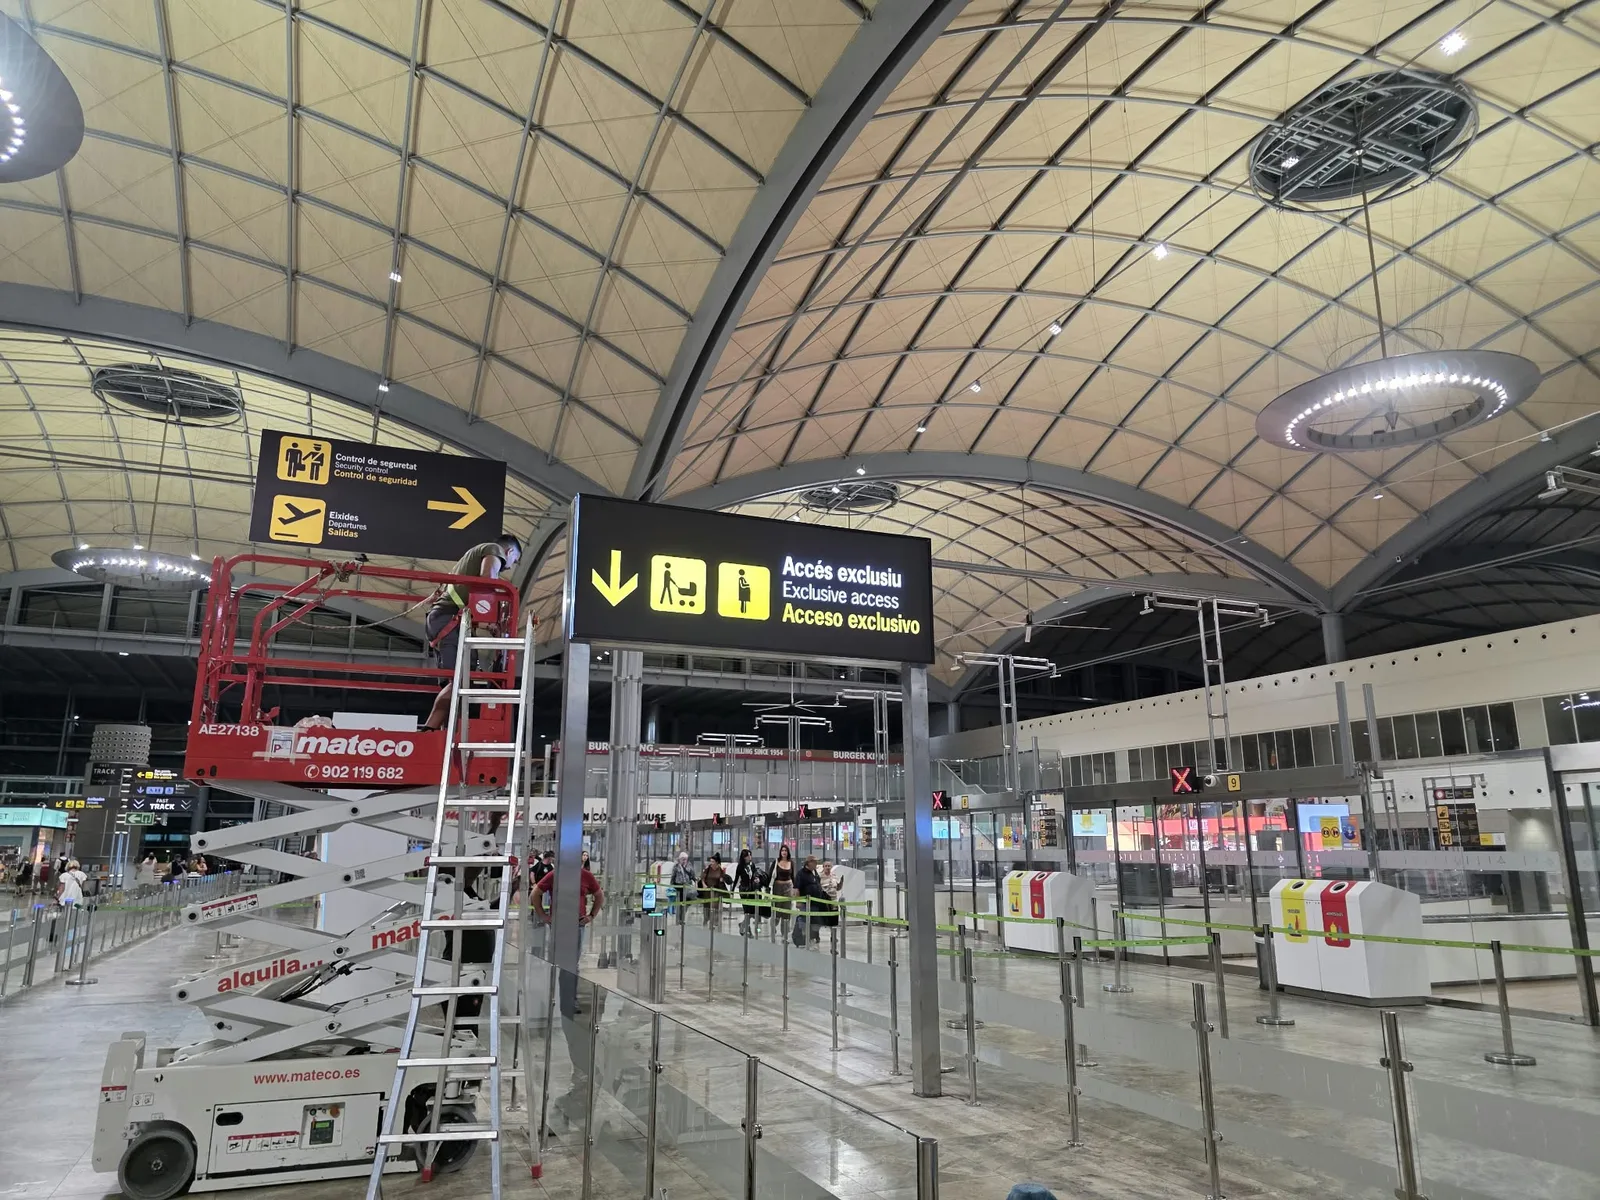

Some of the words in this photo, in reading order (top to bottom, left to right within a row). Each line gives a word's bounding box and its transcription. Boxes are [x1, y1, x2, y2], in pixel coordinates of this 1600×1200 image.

[334, 462, 363, 472] Security
[364, 466, 389, 474] control
[335, 453, 366, 464] Control
[379, 460, 417, 470] seguretat
[333, 469, 364, 480] Control
[365, 473, 377, 481] de
[378, 476, 418, 486] seguridad
[329, 511, 359, 521] Eixides
[328, 519, 367, 530] Departures
[327, 527, 359, 538] Salidas
[782, 555, 833, 581] Accés
[837, 564, 902, 588] exclusiu
[782, 580, 847, 604] Exclusive
[850, 591, 900, 609] access
[781, 602, 843, 627] Acceso
[847, 611, 920, 635] exclusivo
[198, 723, 260, 737] AE27138
[295, 734, 414, 757] mateco
[833, 751, 866, 760] BURGER
[321, 765, 350, 778] 902
[352, 766, 374, 779] 119
[377, 767, 404, 779] 682
[1230, 777, 1237, 788] 9
[253, 1068, 361, 1085] www.mateco.es
